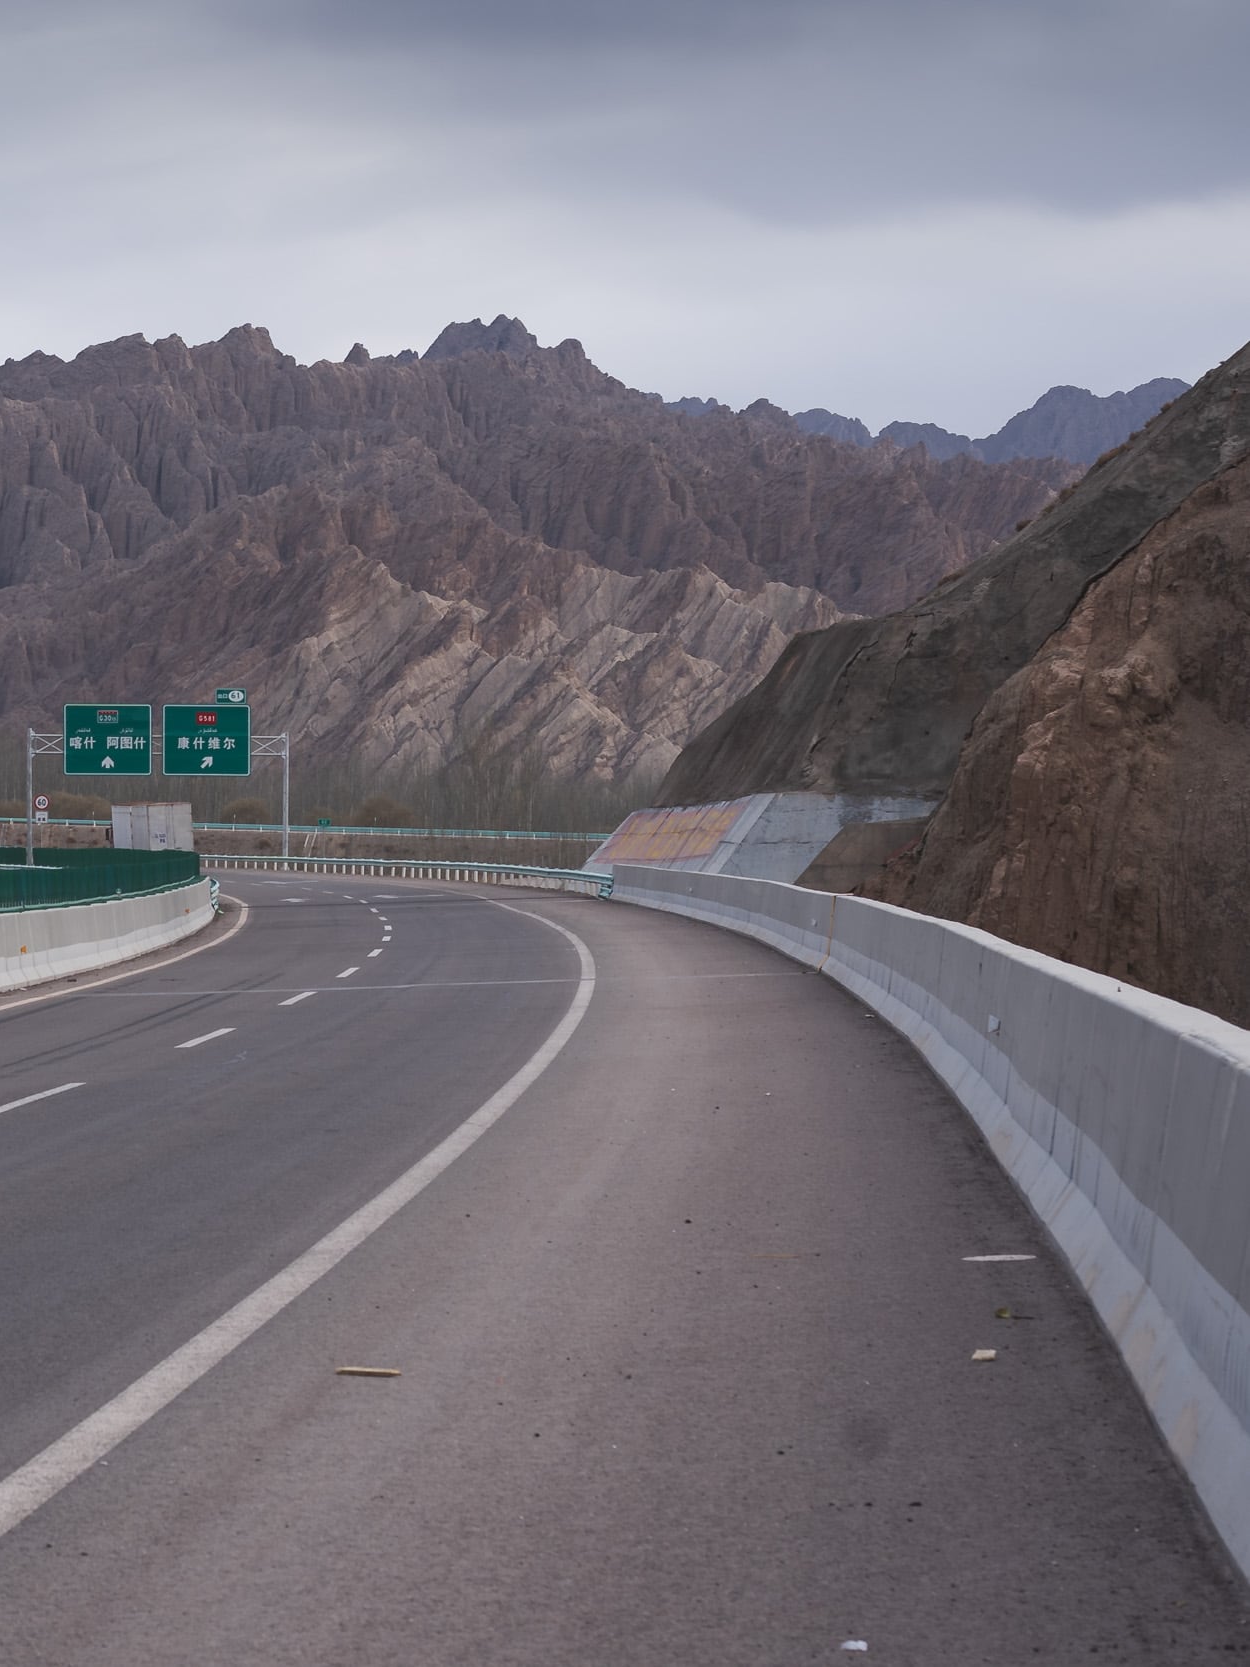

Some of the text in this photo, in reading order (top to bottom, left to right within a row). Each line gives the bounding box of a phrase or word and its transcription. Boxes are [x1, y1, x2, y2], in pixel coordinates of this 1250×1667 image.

[69, 736, 147, 750] 喀什 阿图什
[177, 736, 236, 750] 康什维尔
[37, 798, 47, 807] 60
